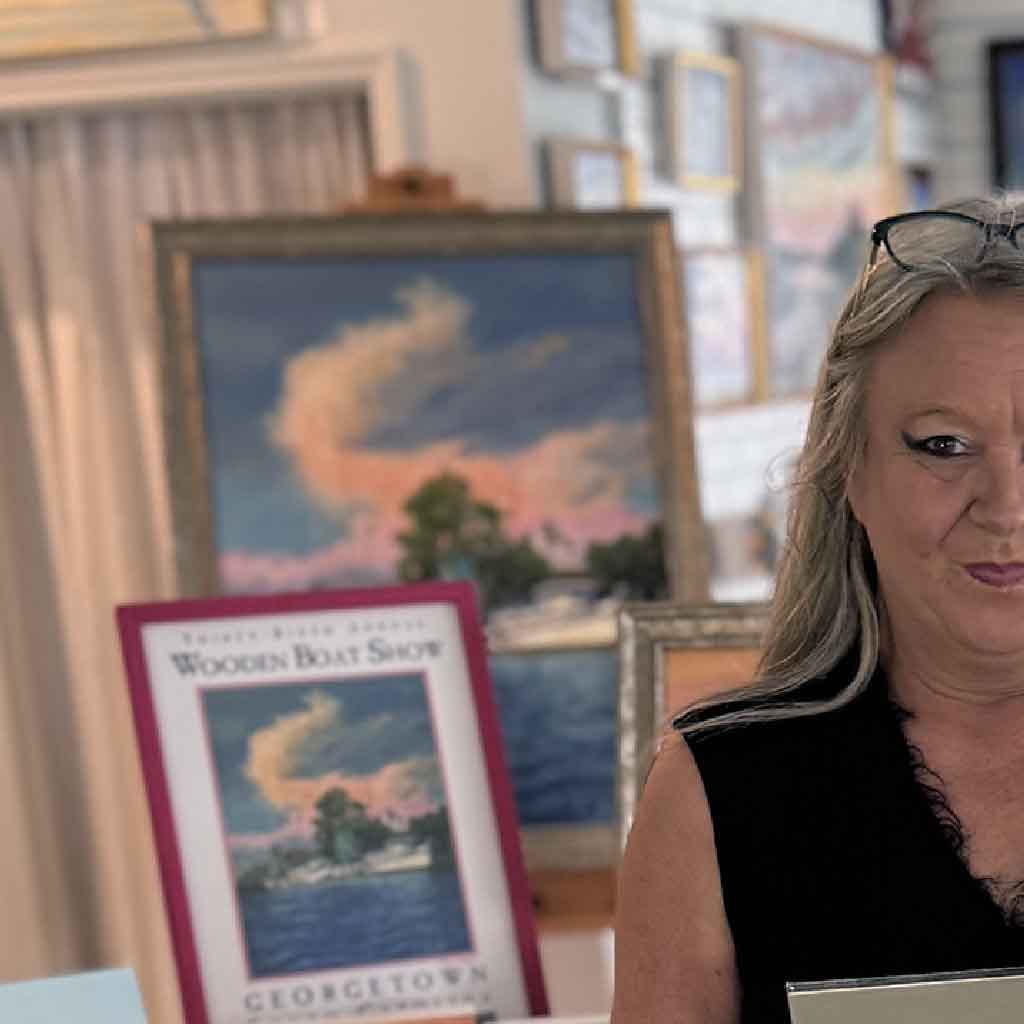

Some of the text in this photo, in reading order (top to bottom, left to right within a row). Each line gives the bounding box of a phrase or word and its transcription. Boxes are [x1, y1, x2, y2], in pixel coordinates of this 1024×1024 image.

[293, 643, 359, 670] BOAT
[367, 638, 444, 664] SHOW
[245, 966, 488, 1013] GEORGETOWN
